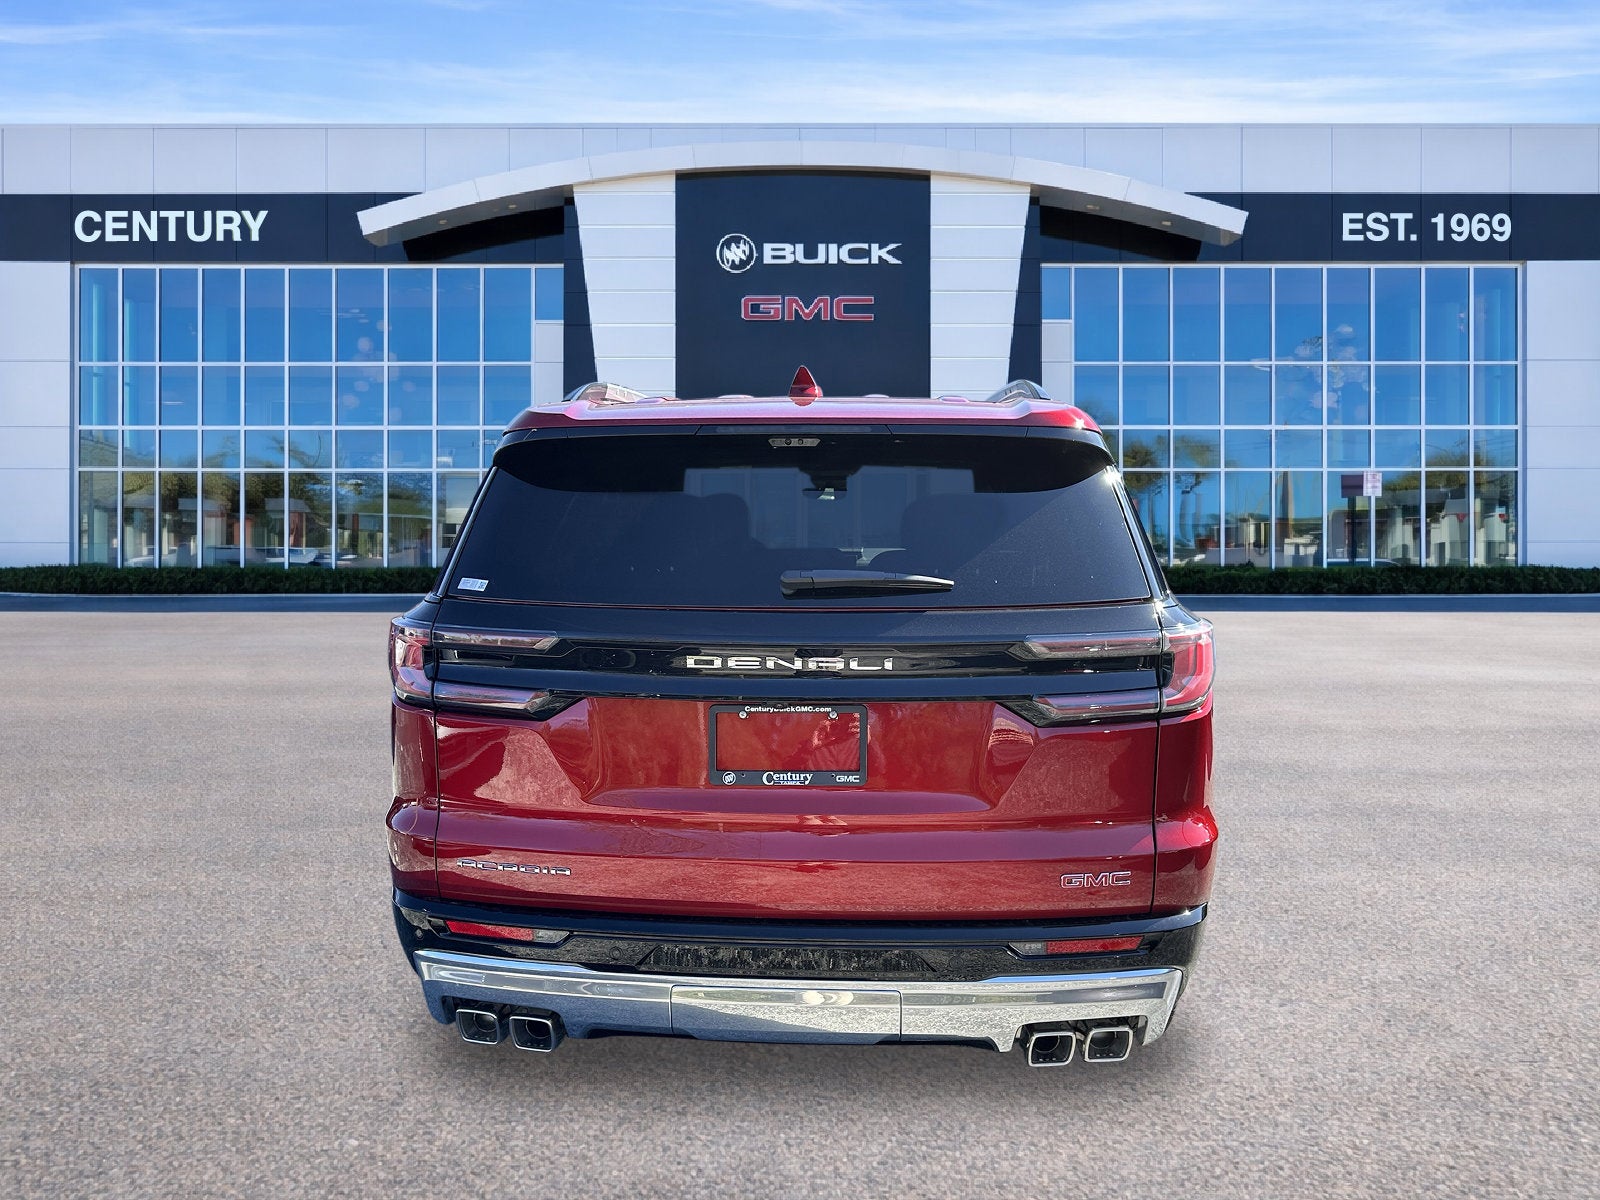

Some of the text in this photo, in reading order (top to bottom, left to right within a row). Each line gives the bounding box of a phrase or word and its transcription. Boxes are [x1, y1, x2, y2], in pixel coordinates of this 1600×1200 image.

[74, 210, 269, 242] CENTURY
[1342, 212, 1512, 242] EST. 1969
[763, 243, 903, 265] BUICK
[741, 295, 875, 321] GMC
[686, 655, 893, 671] DENALI
[762, 771, 813, 786] Century
[836, 775, 860, 783] GMC
[456, 858, 571, 876] ACADIA
[1060, 871, 1132, 889] GMC
